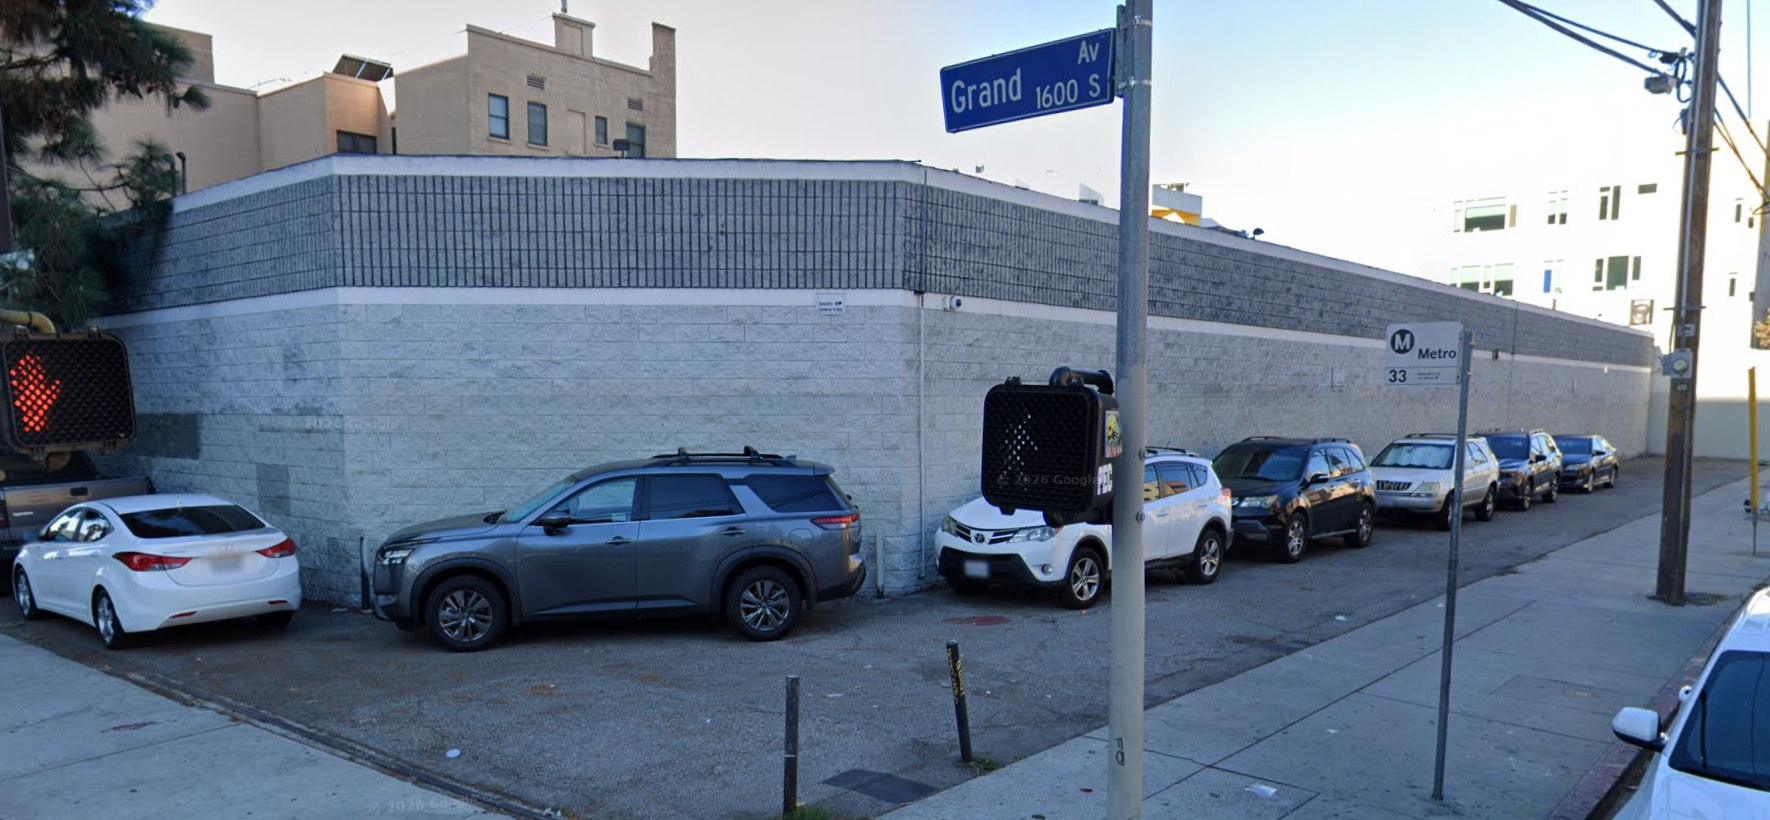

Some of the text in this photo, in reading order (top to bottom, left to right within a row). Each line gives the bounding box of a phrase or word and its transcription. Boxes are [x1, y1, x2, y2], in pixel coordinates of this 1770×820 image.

[1077, 40, 1100, 65] Av
[951, 67, 1022, 113] Grand
[1036, 73, 1100, 110] 1600 S
[1394, 333, 1411, 351] M
[1418, 348, 1457, 360] Metro
[1388, 369, 1407, 383] 33
